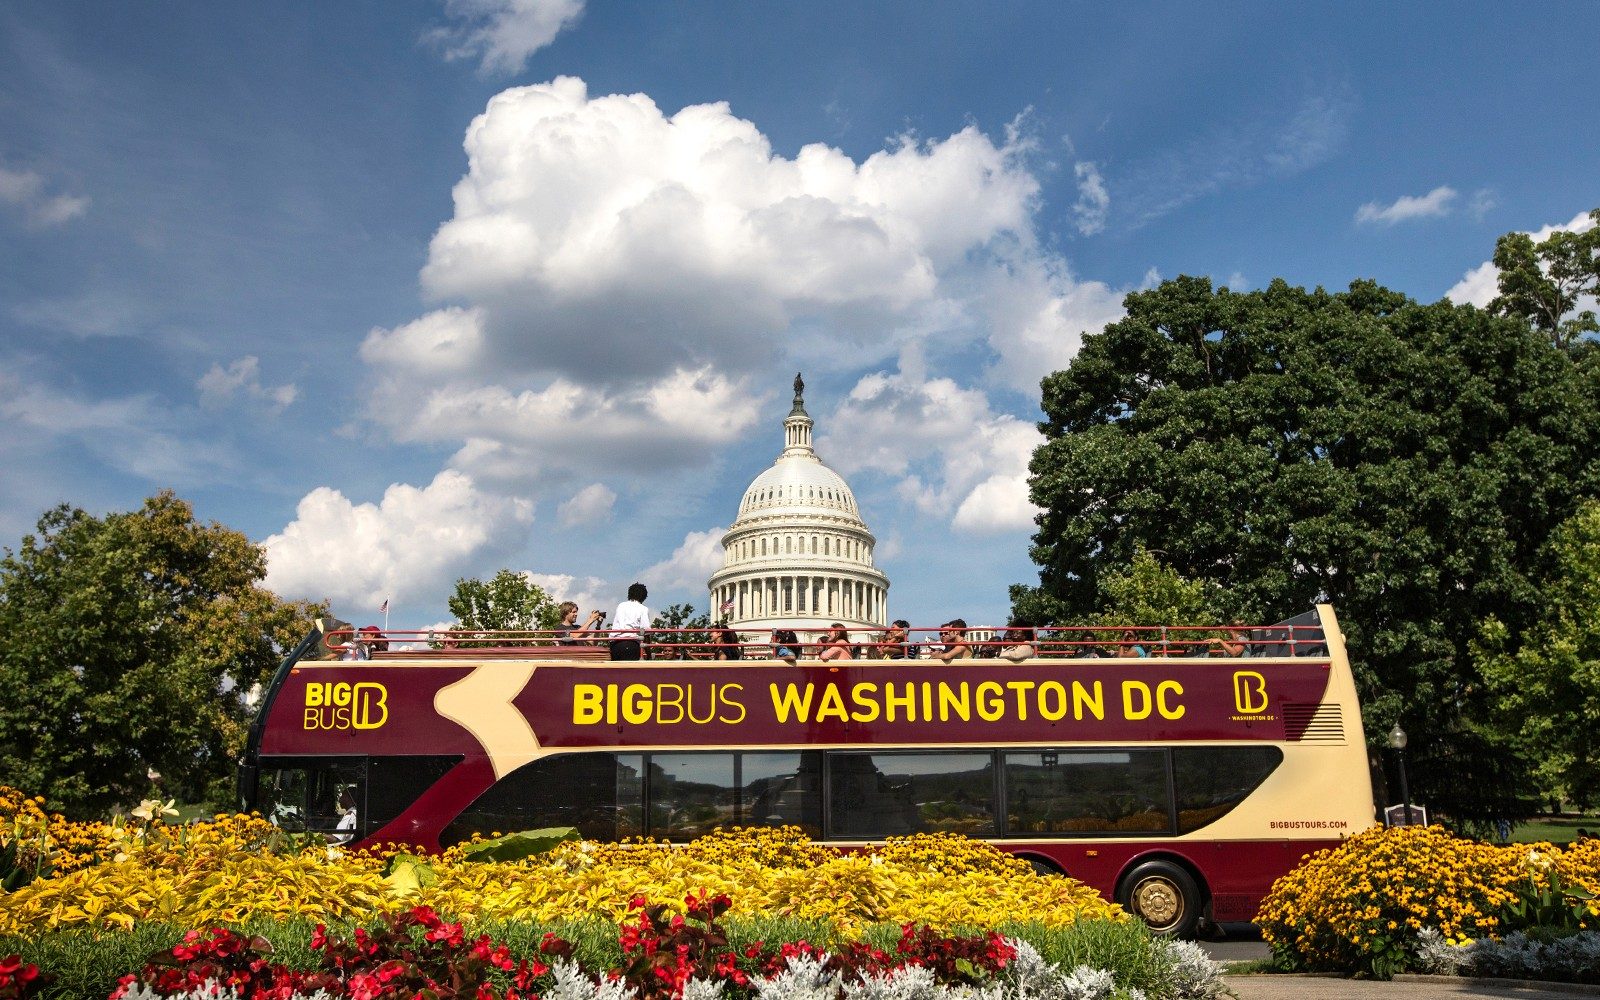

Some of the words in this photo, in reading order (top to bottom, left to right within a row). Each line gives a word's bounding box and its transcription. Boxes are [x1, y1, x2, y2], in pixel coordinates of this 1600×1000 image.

[305, 682, 352, 707] BIG
[769, 680, 1105, 725] WASHINGTON
[1121, 679, 1186, 722] DC
[303, 707, 351, 730] BUS
[1270, 821, 1348, 829] BIGBUSTOURS.COM
